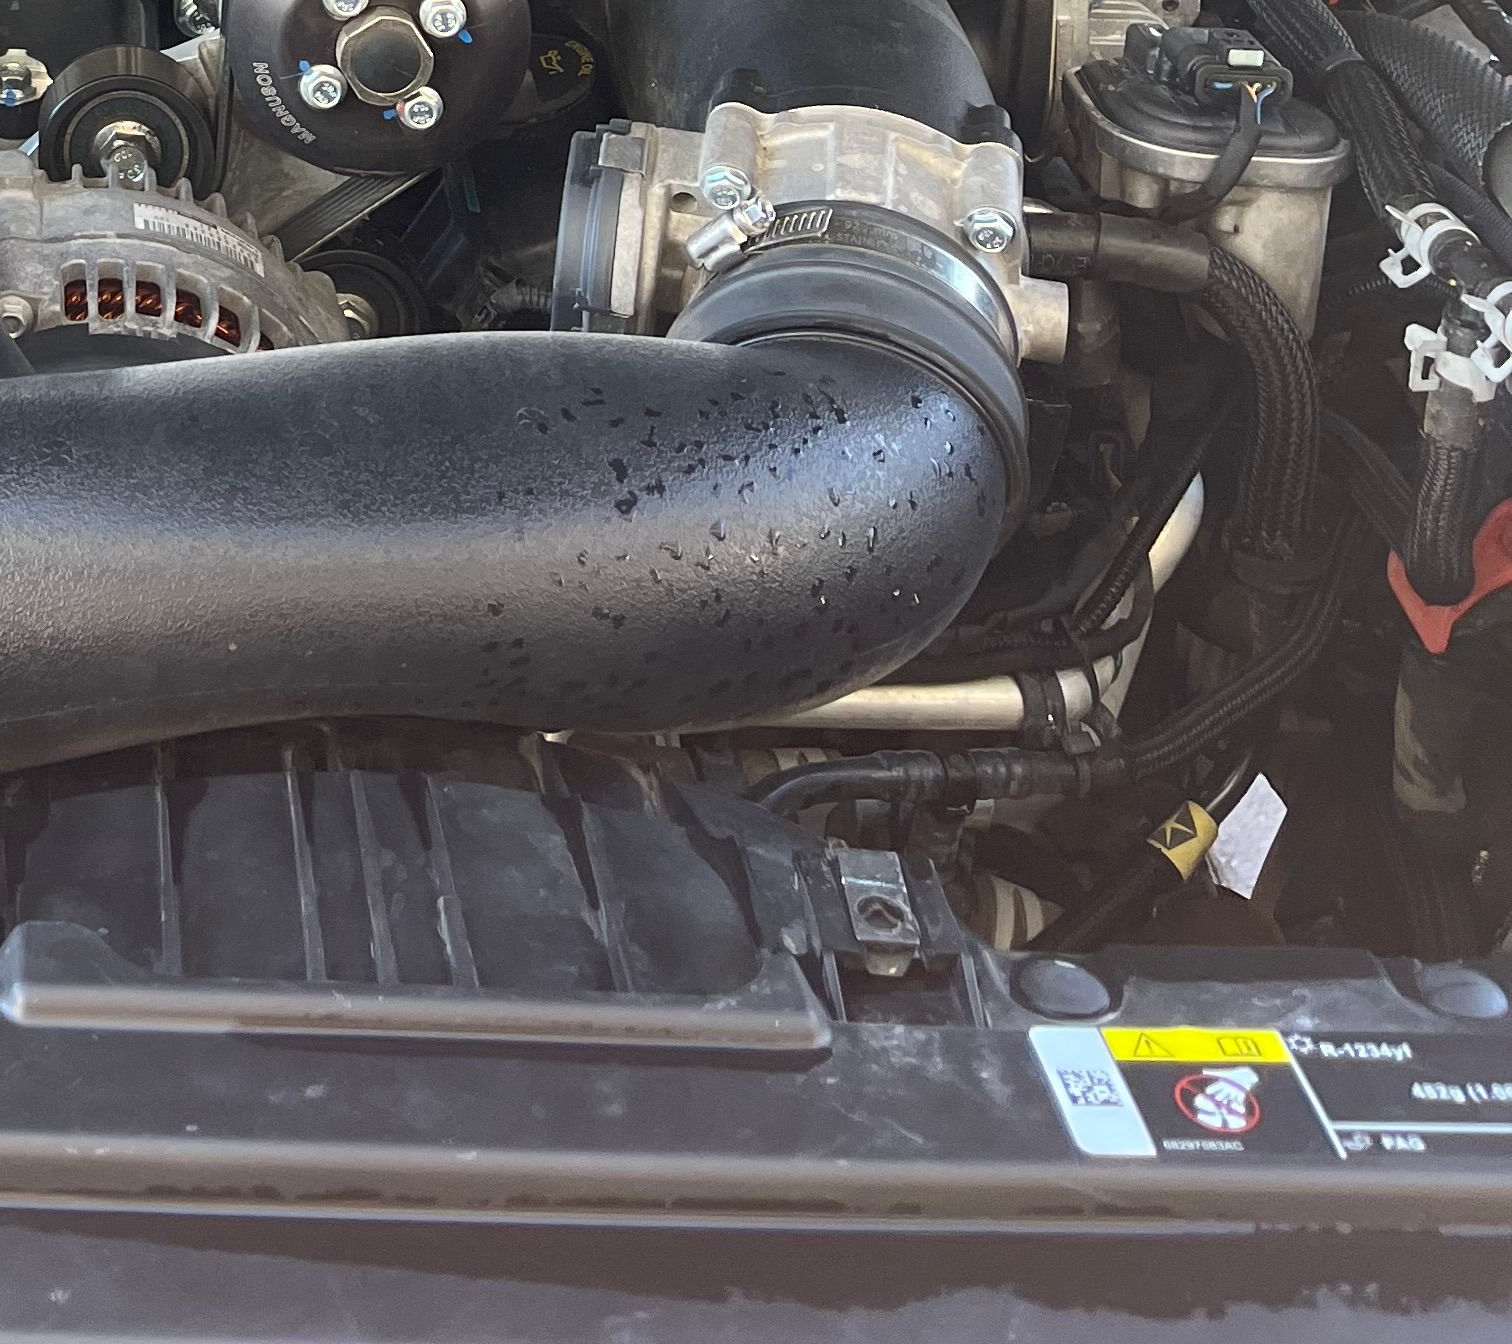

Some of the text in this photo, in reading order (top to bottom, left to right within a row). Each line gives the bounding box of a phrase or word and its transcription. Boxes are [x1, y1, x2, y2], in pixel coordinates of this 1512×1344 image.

[252, 62, 317, 144] MAGNUSON
[1319, 1041, 1413, 1062] R-1234yf
[1380, 1134, 1426, 1152] PAG
